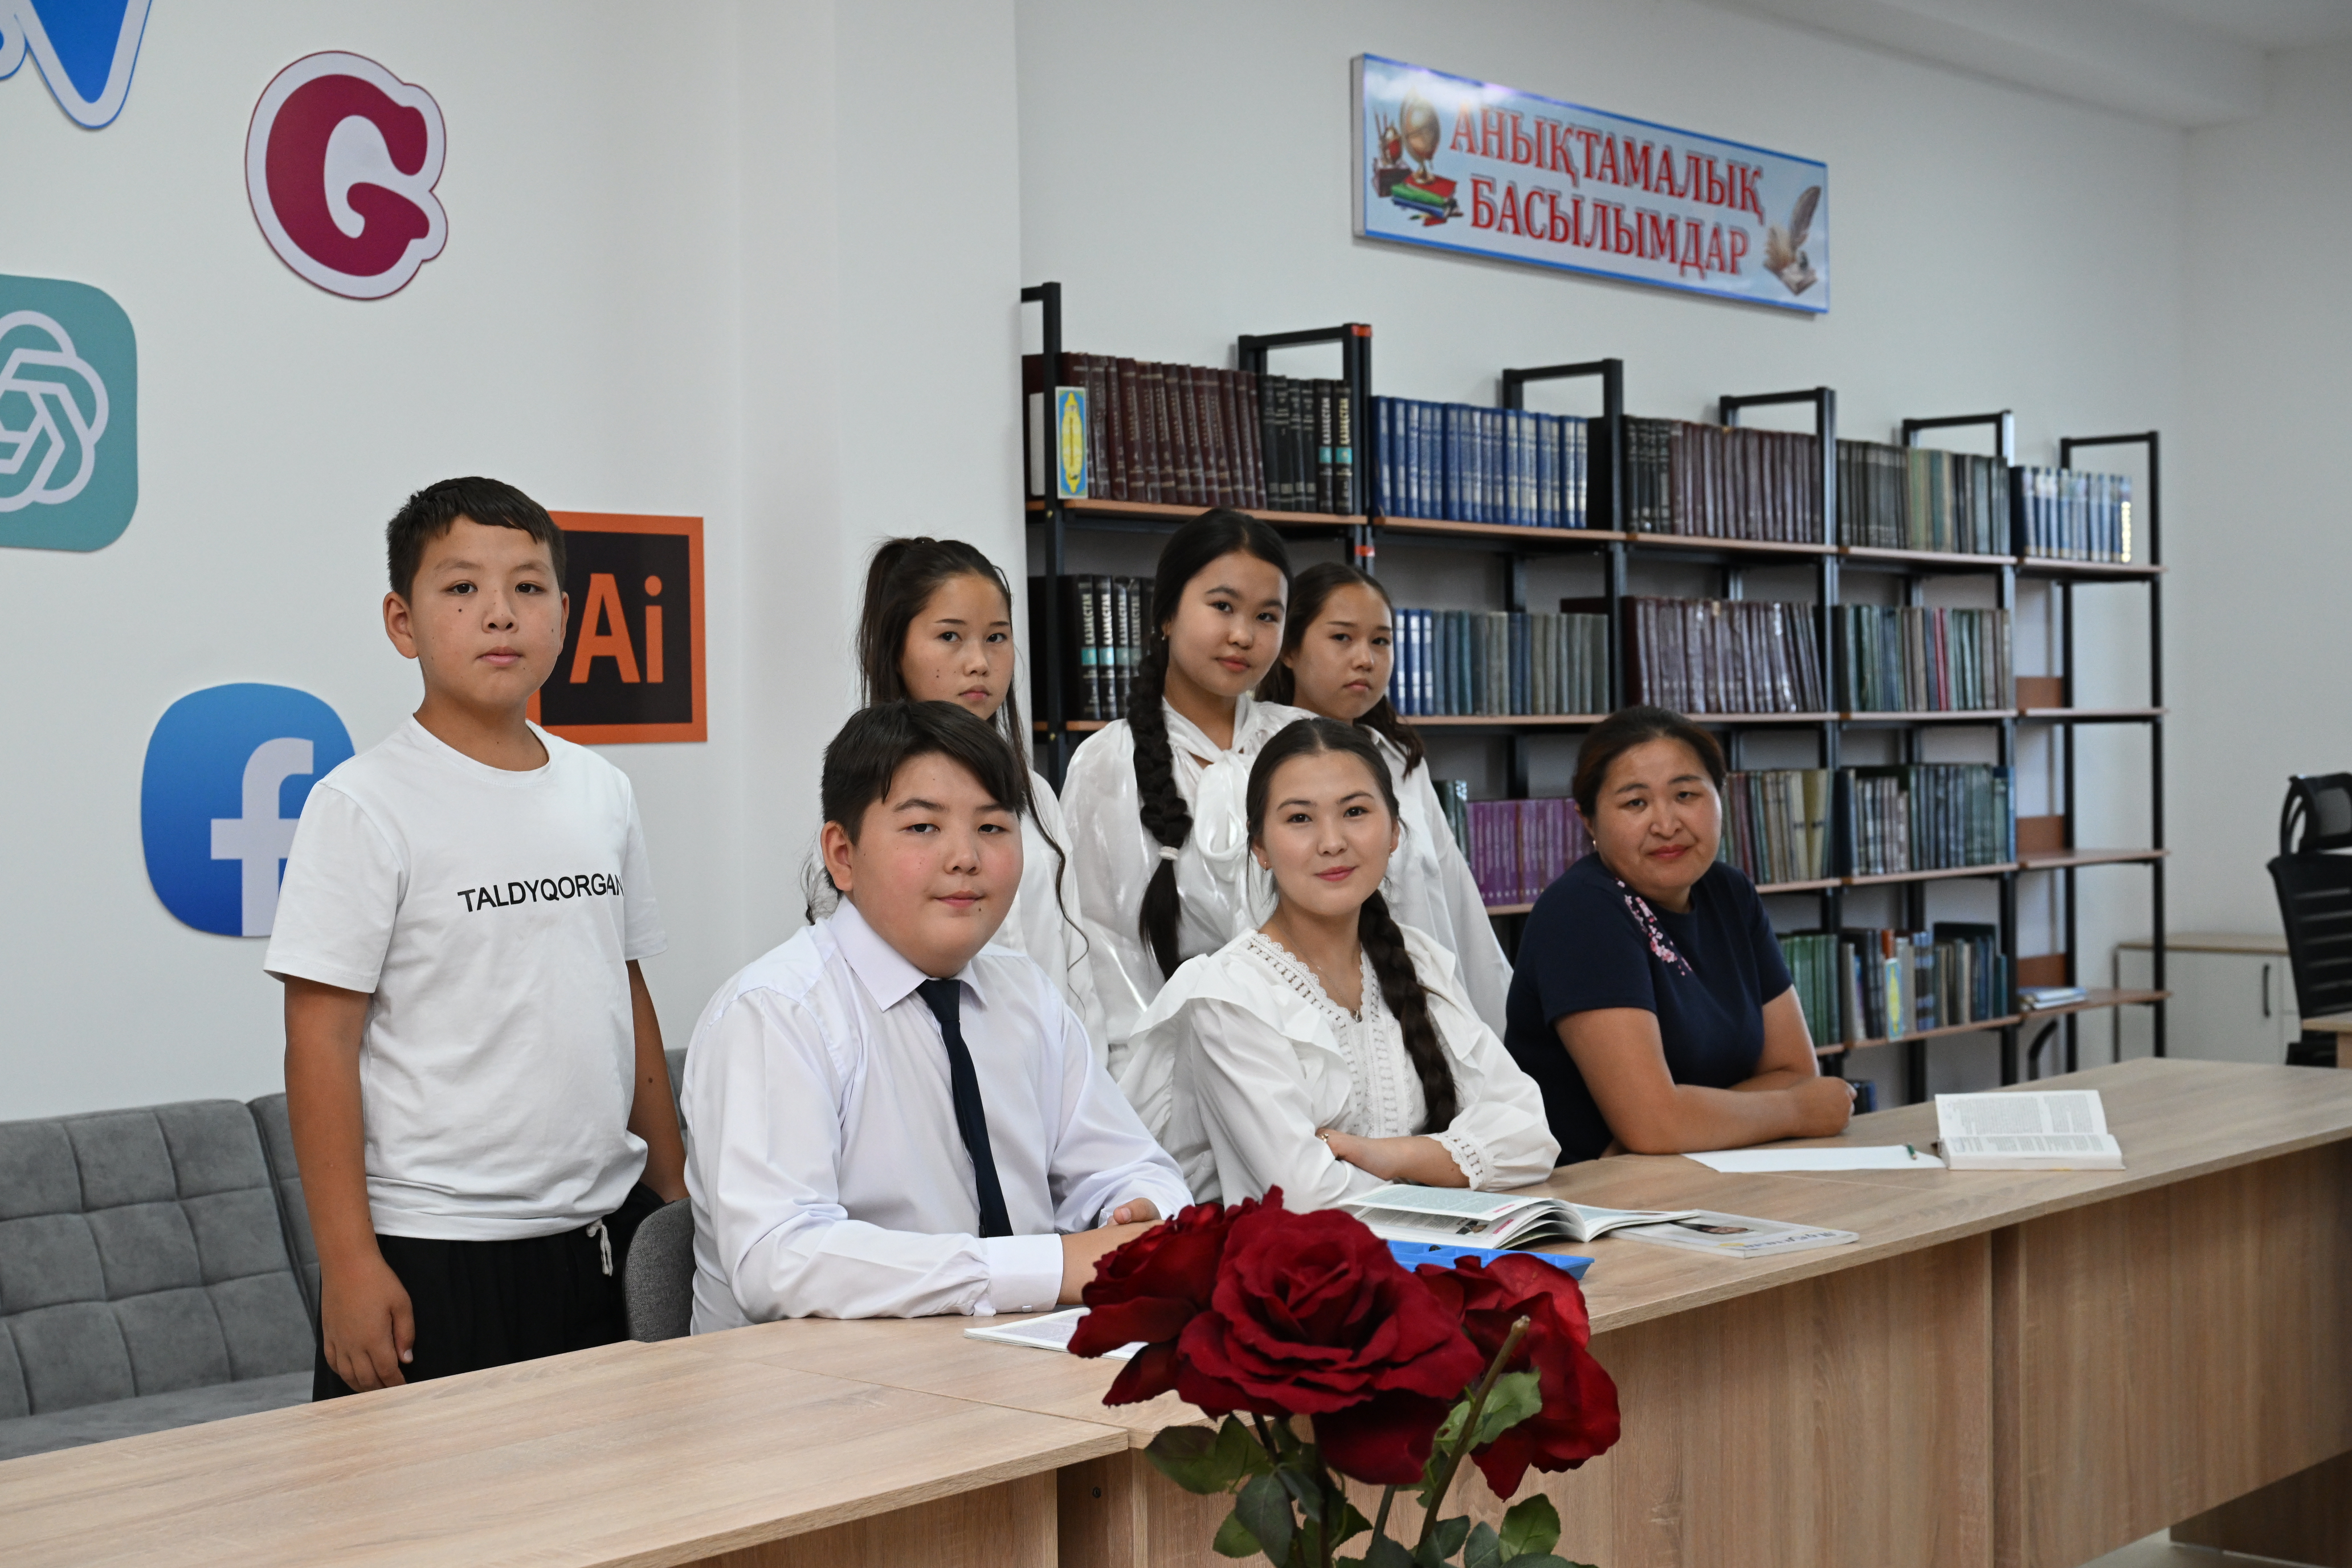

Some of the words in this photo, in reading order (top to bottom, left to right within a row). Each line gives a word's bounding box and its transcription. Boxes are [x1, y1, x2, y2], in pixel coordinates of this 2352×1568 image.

[266, 74, 430, 277] G
[1449, 101, 1763, 226] АНЫҚТАМАЛЫҚ
[1469, 174, 1749, 280] БАСЫЛЫМДАР
[570, 573, 664, 684] Ai
[457, 873, 624, 912] TALDYQORGAN
